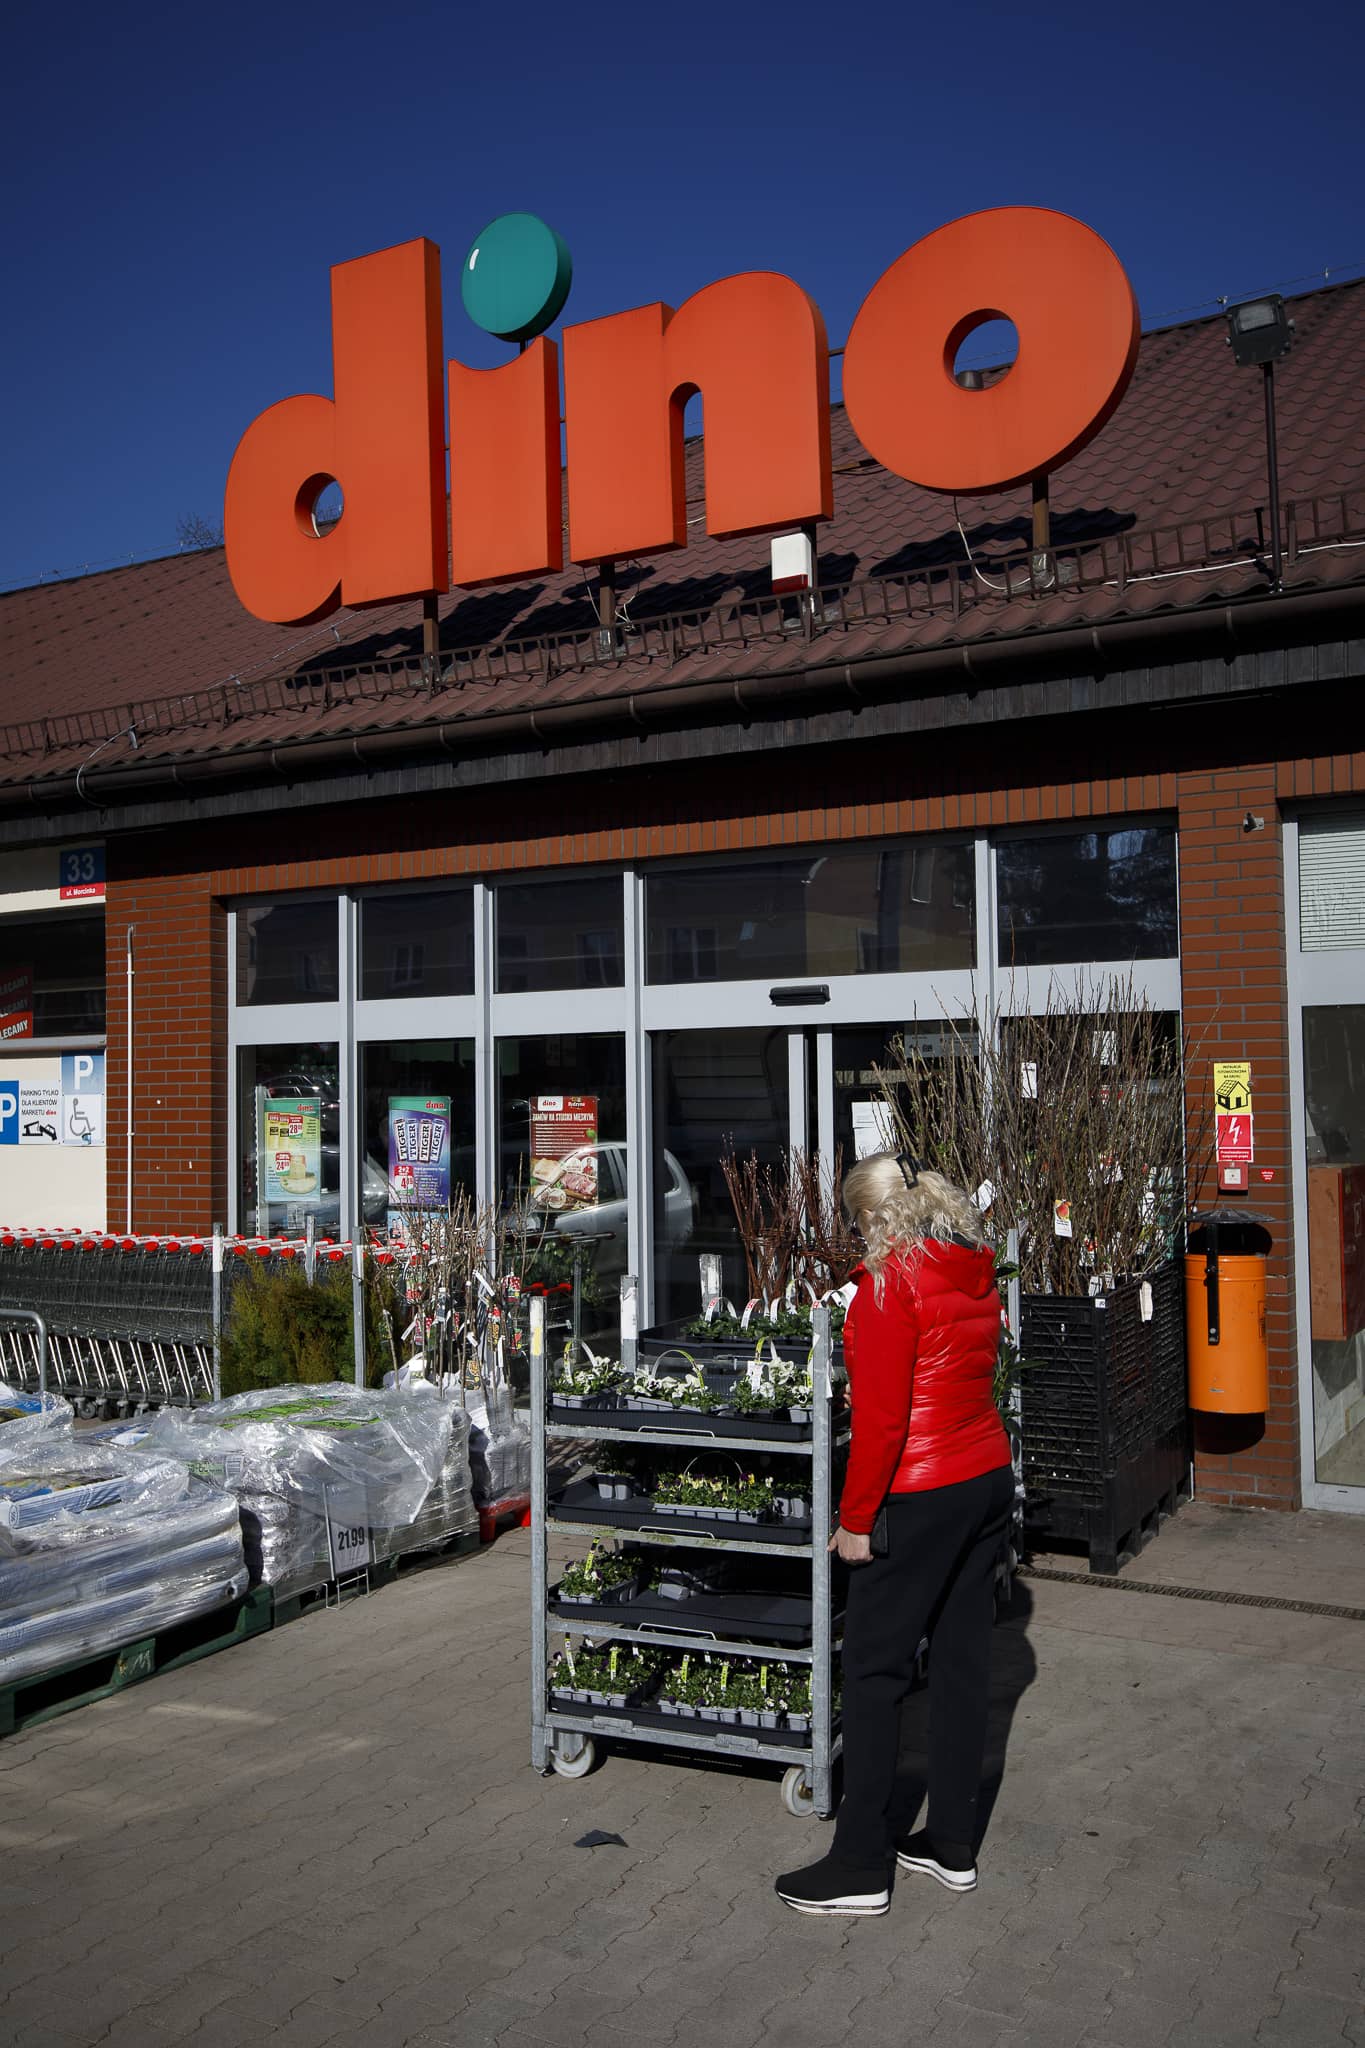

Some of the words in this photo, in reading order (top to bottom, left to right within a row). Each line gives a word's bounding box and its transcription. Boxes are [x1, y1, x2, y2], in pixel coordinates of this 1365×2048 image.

[224, 205, 1140, 624] dino
[67, 853, 95, 882] 33
[74, 1055, 93, 1090] P
[0, 1093, 17, 1133] P
[32, 1098, 57, 1106] KLIENTÓW
[398, 1124, 408, 1157] TIGER
[409, 1125, 417, 1157] TIGER
[421, 1126, 429, 1157] TIGER
[431, 1126, 442, 1157] TIGER
